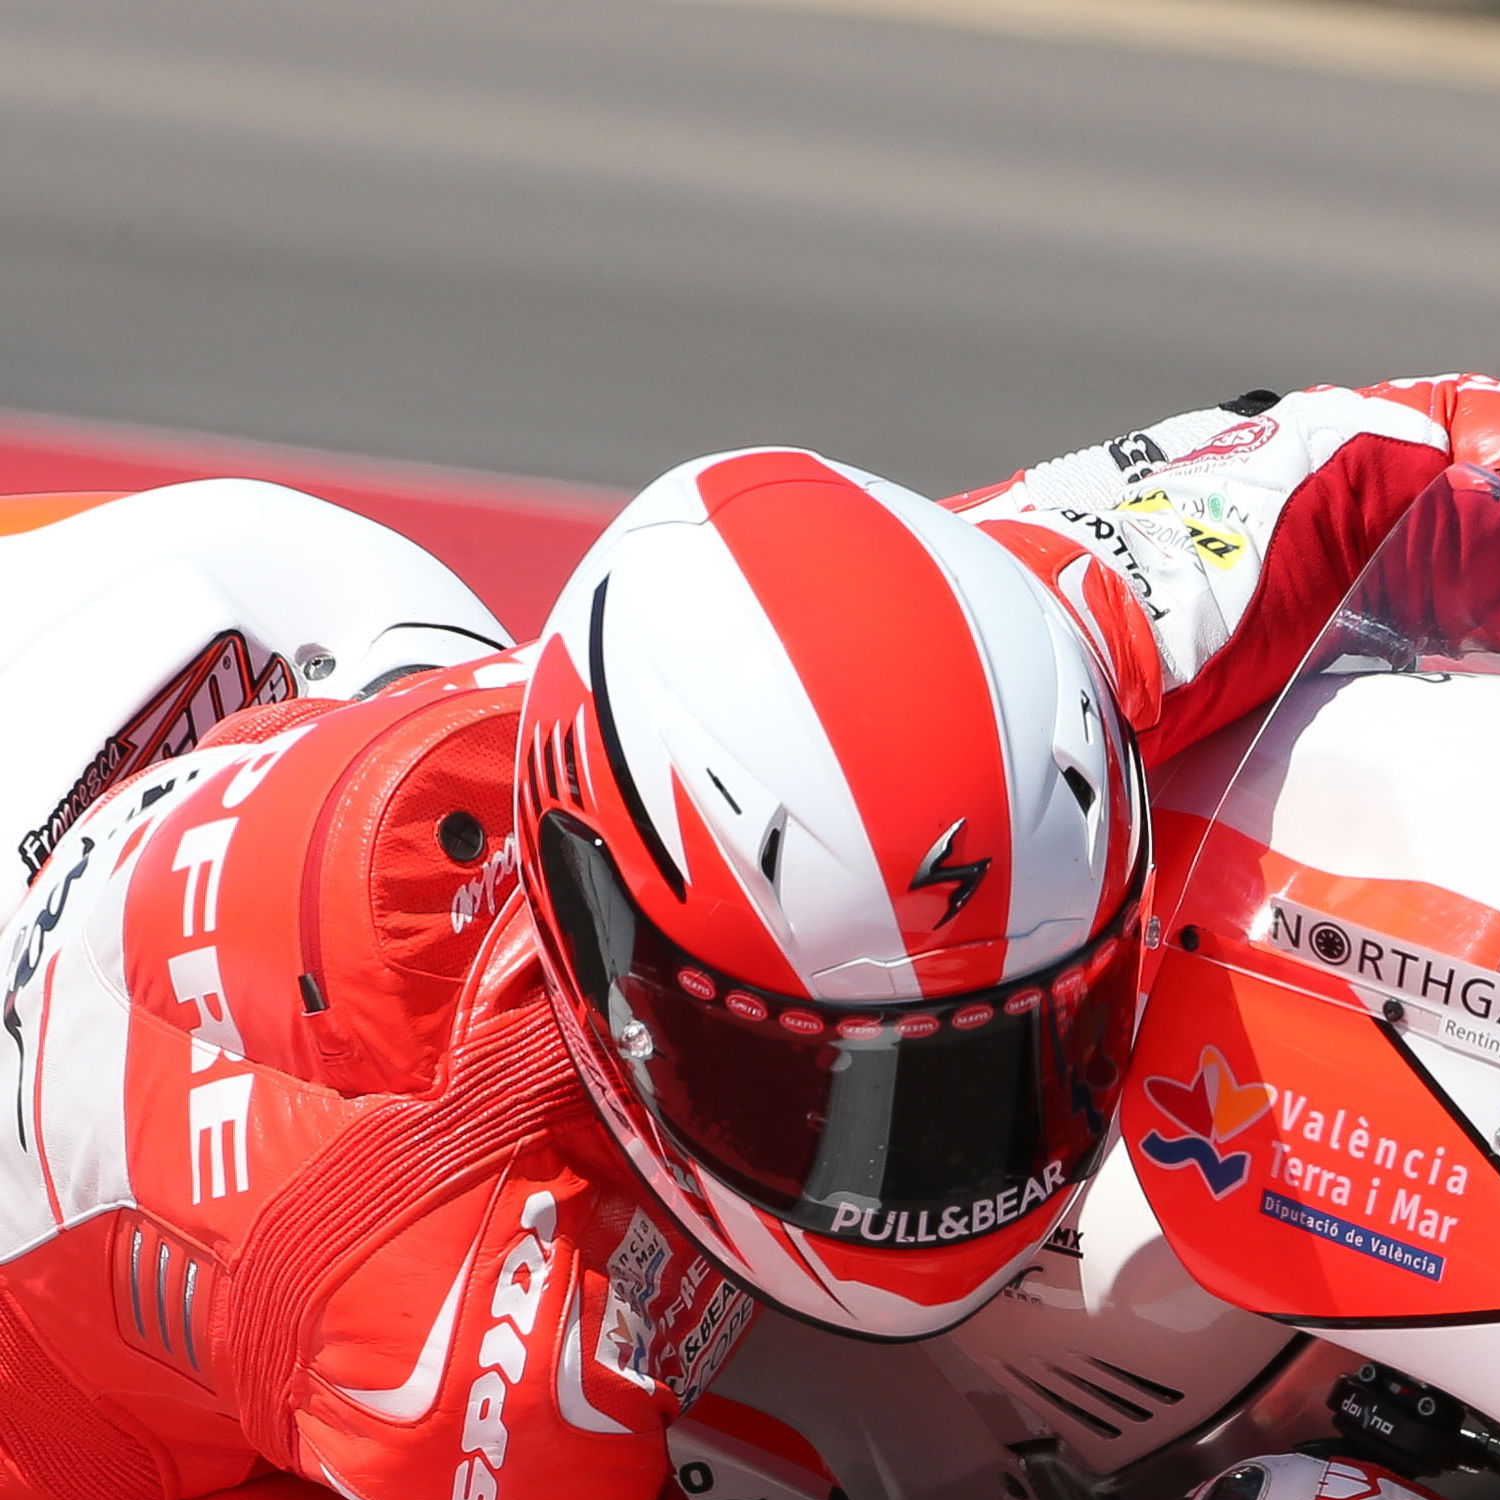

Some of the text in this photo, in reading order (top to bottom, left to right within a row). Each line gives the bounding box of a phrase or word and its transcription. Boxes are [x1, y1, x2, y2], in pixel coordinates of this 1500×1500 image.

[1281, 1089, 1468, 1195] València
[830, 1159, 1066, 1247] PULL&BEAR
[1264, 1196, 1436, 1275] Diputació de València
[1271, 1139, 1459, 1243] Terra i Mar
